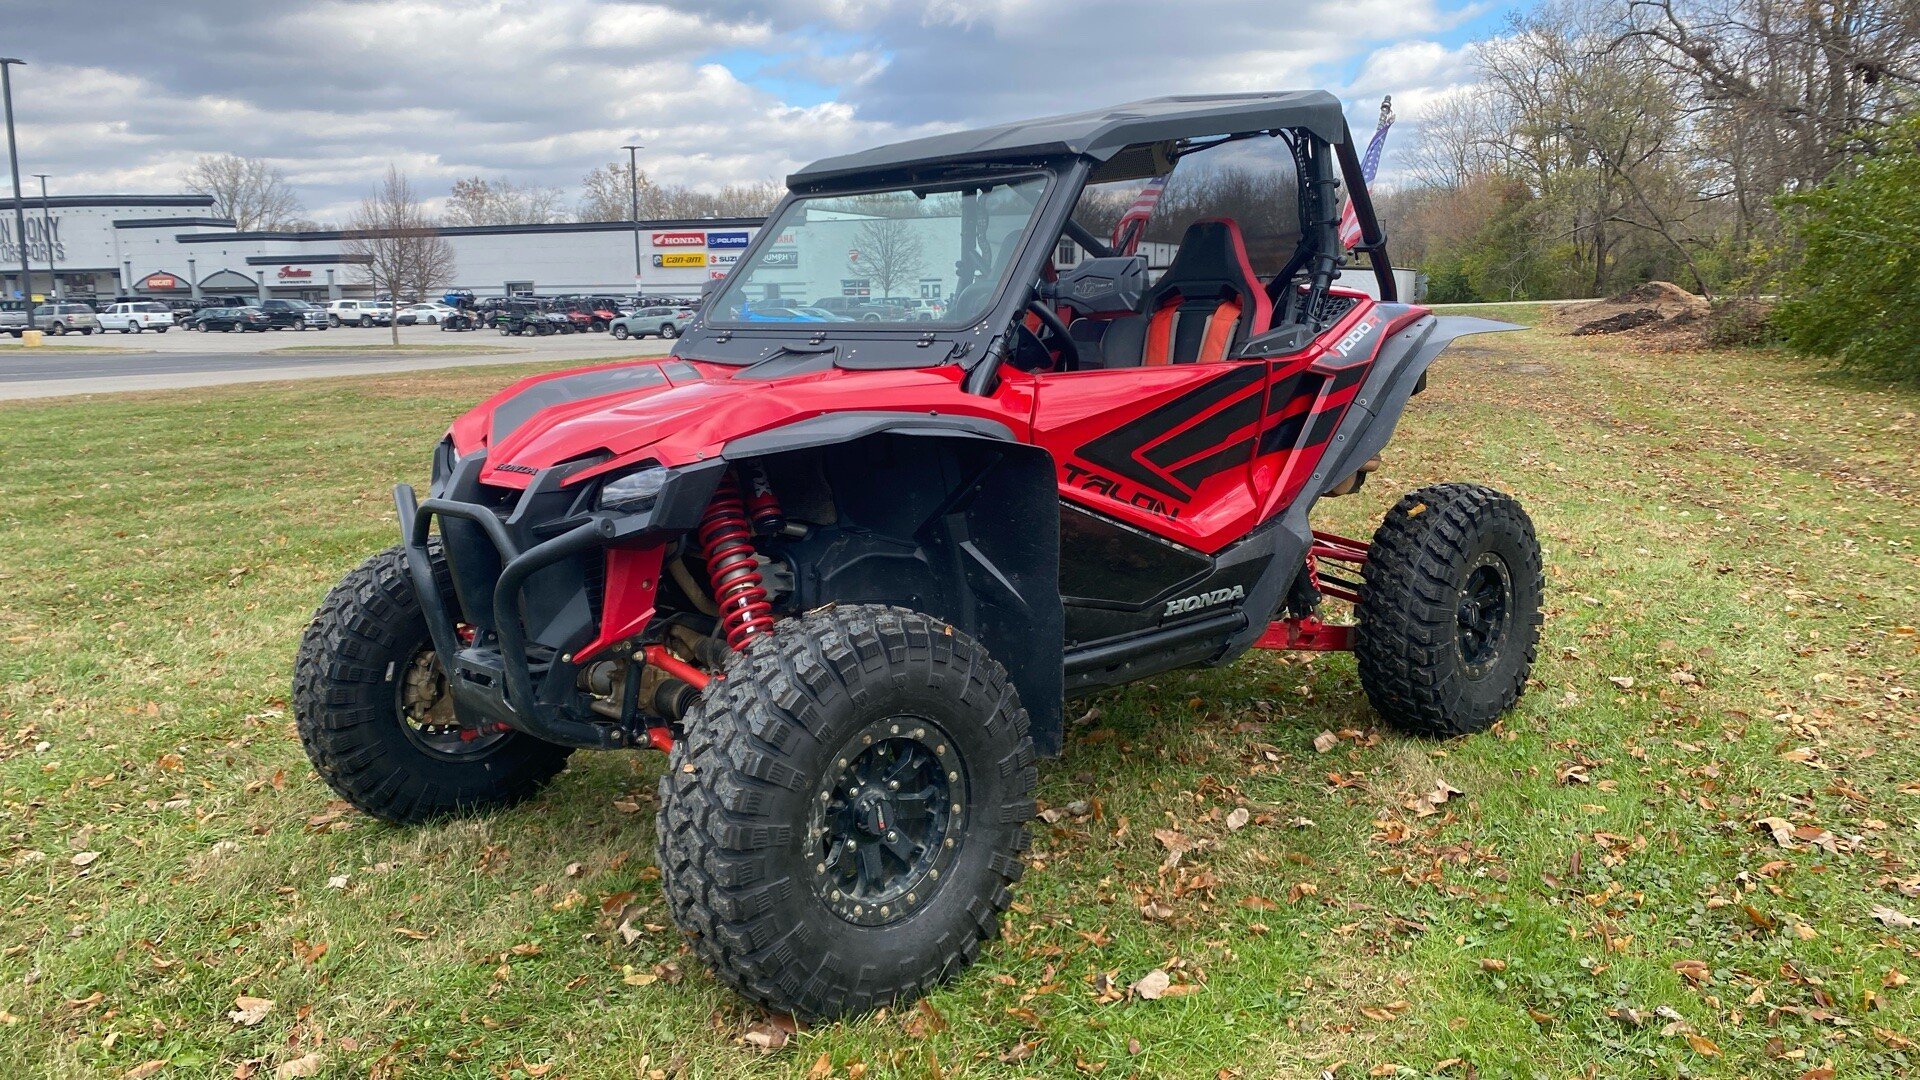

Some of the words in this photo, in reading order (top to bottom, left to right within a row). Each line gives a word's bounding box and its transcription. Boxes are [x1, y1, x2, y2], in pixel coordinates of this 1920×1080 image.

[25, 216, 60, 242] ONY
[663, 237, 704, 245] HONDA
[666, 256, 702, 264] can-am
[763, 253, 788, 261] IUMPH
[495, 463, 539, 476] HONDA
[1063, 463, 1181, 521] TALON
[1163, 584, 1245, 617] HONDA
